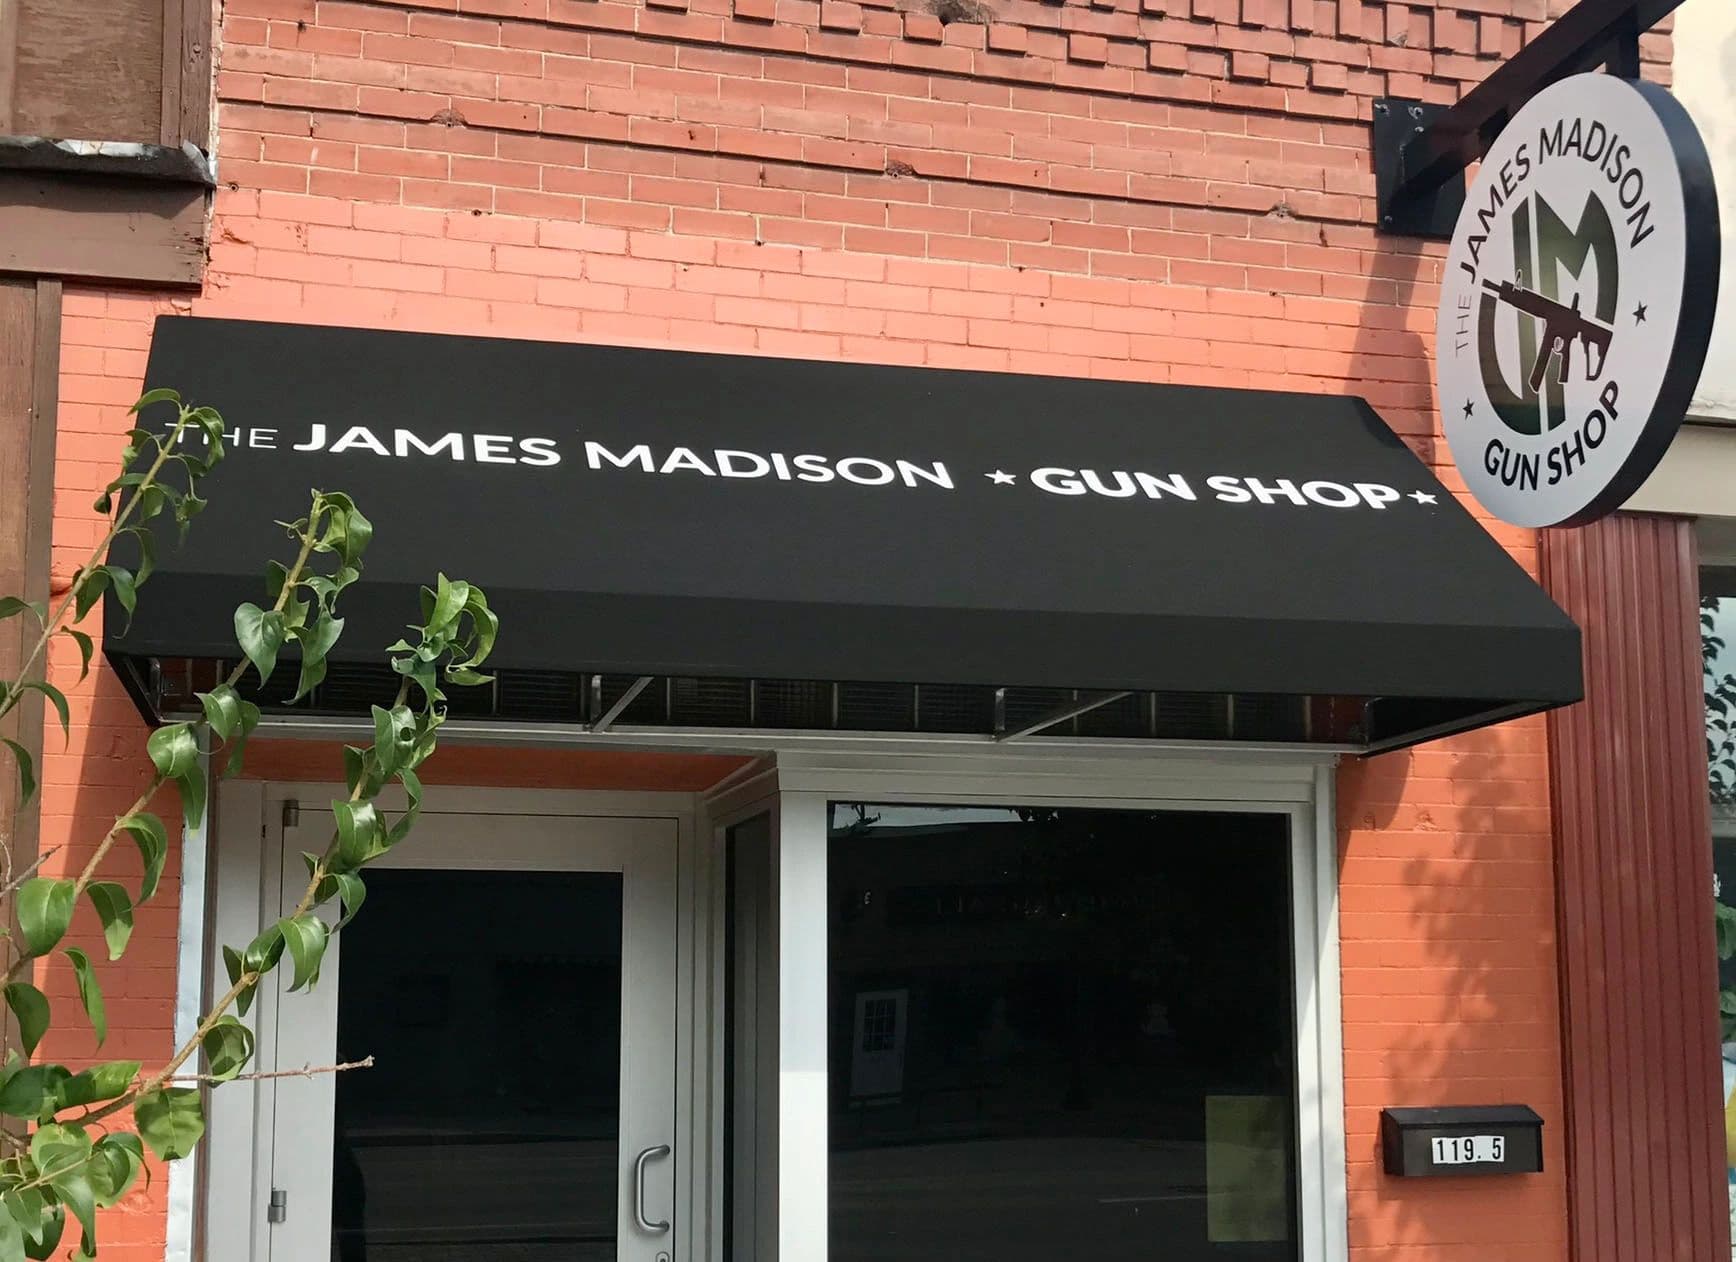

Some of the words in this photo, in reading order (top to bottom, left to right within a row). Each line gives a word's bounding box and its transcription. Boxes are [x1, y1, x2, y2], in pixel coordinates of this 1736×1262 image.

[1460, 143, 1531, 285] JAMES
[1538, 117, 1655, 249] MADISON
[1455, 293, 1473, 358] THE
[293, 423, 561, 467] JAMES
[584, 441, 955, 490] MADISON
[1031, 467, 1197, 502] GUN
[1207, 475, 1402, 511] SHOP
[1483, 437, 1541, 491] GUN
[1546, 379, 1620, 486] SHOP
